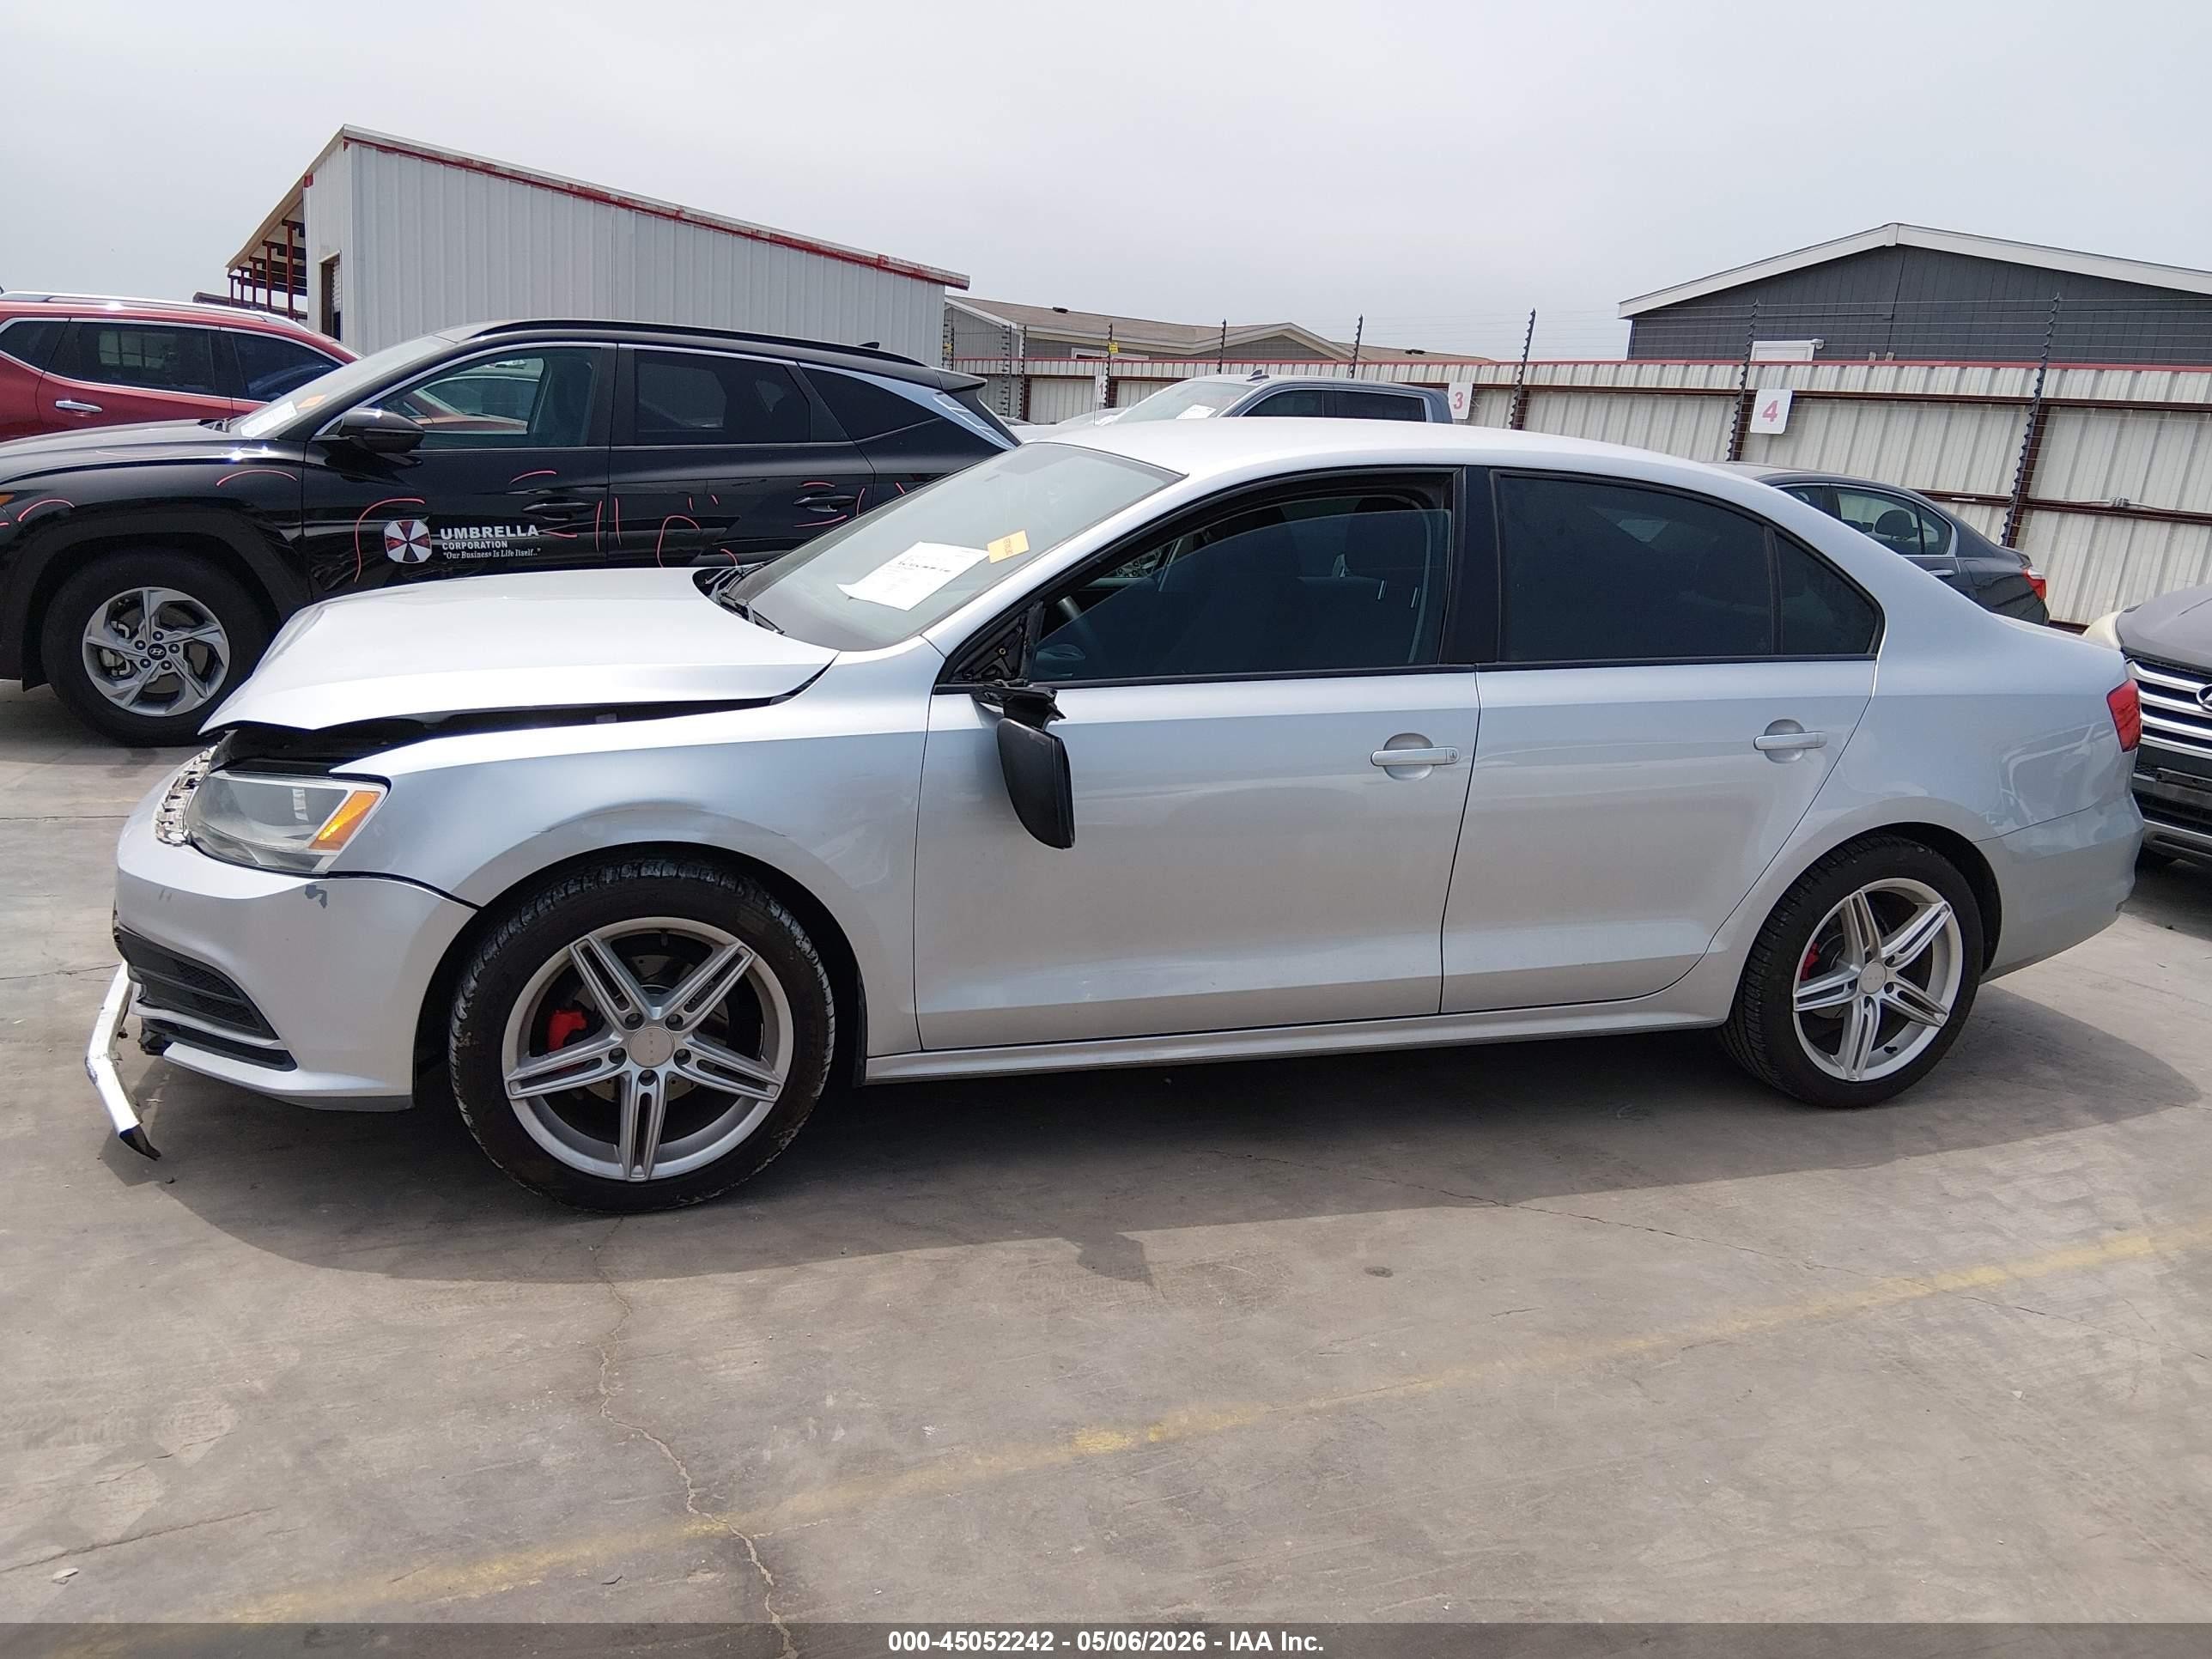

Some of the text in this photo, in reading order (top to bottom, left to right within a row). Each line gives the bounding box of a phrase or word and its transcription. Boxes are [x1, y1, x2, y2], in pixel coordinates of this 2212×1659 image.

[1453, 392, 1464, 410] 3
[1762, 400, 1778, 422] 4
[440, 525, 539, 540] UMBRELLA
[442, 540, 508, 550] CORPORATION
[461, 550, 492, 559] Business
